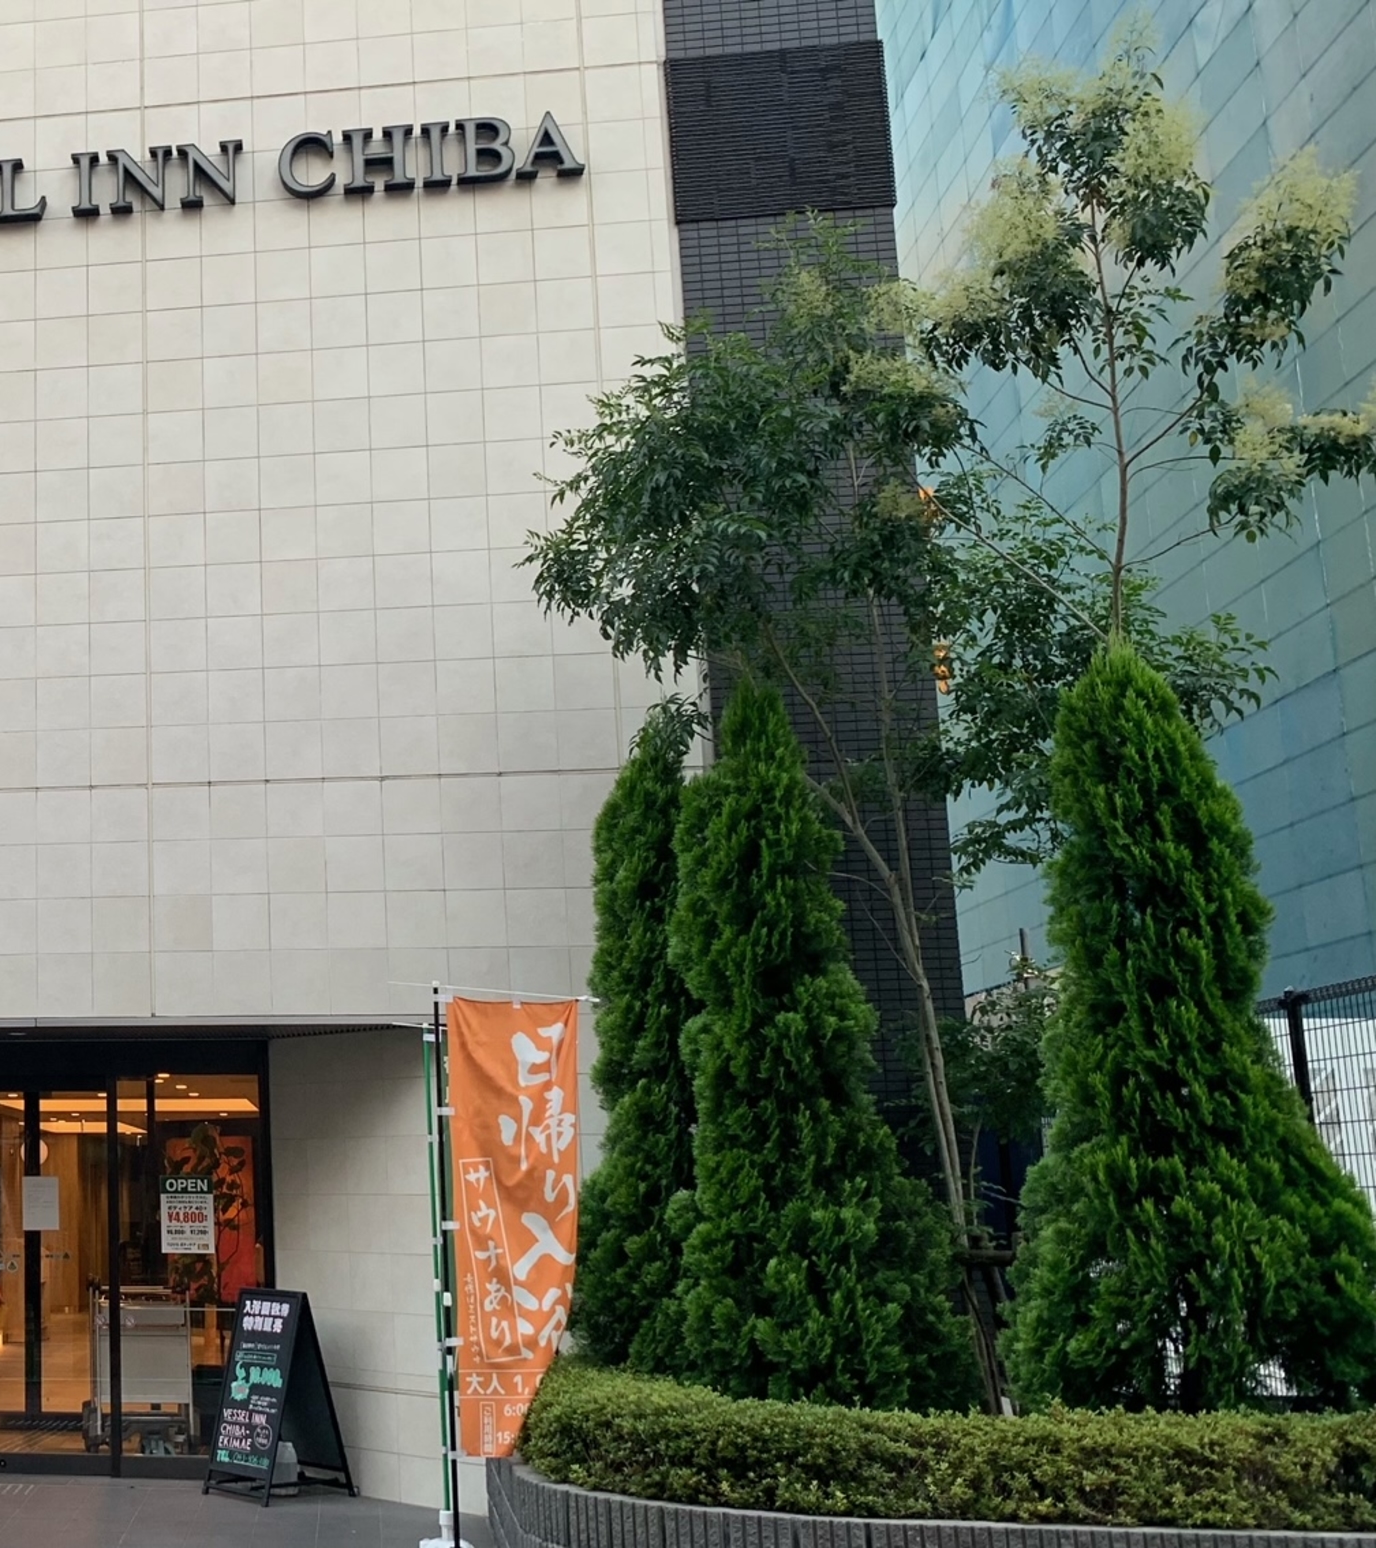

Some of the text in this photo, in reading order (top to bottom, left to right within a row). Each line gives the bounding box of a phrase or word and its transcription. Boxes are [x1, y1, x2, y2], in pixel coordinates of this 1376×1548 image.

[71, 140, 242, 218] INN
[278, 110, 586, 200] CHIBA
[165, 1178, 209, 1192] OPEN
[464, 1164, 512, 1354] サウナあり
[465, 1372, 506, 1395] 大人
[218, 1436, 252, 1450] EKIMAE
